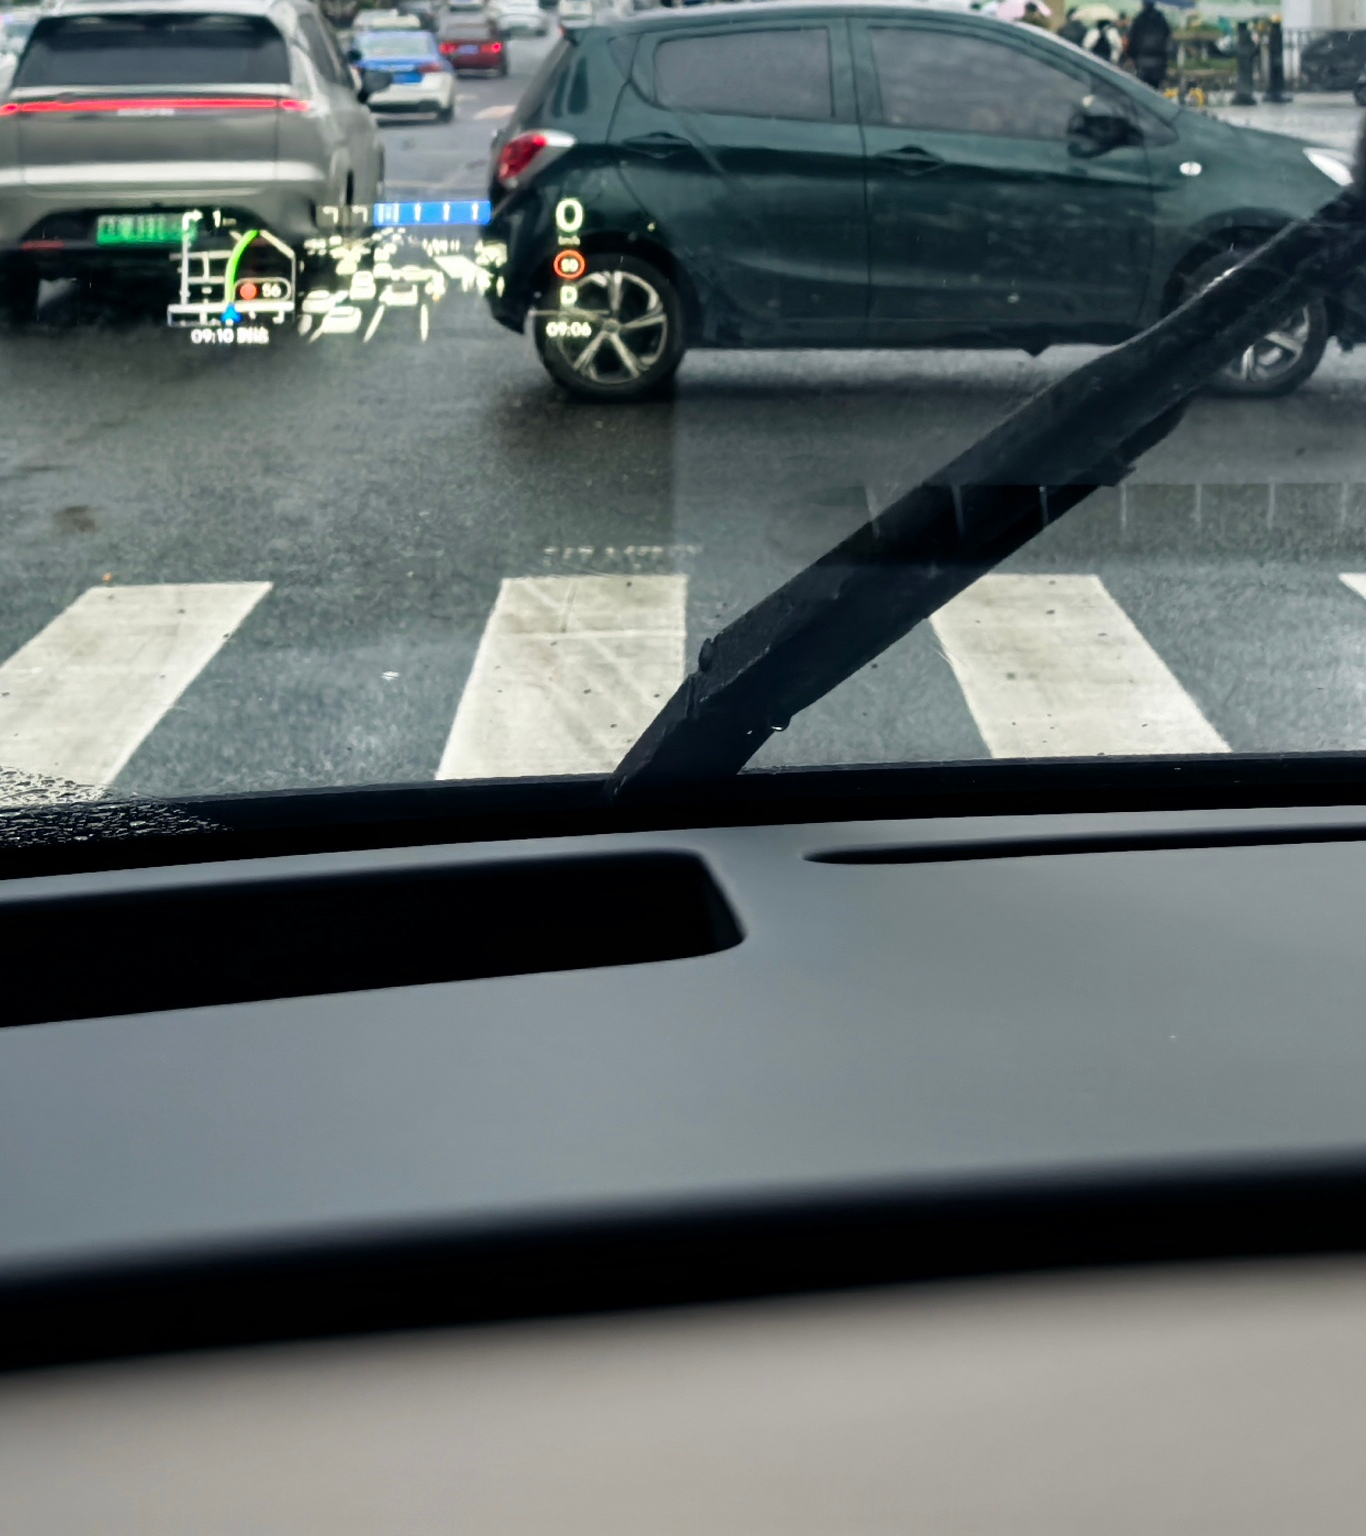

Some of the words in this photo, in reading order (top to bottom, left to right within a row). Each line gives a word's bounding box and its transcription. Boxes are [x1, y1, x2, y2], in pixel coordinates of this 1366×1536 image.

[555, 198, 584, 233] 0
[560, 285, 578, 306] D
[191, 328, 234, 344] 09:10
[546, 321, 592, 337] 09:06
